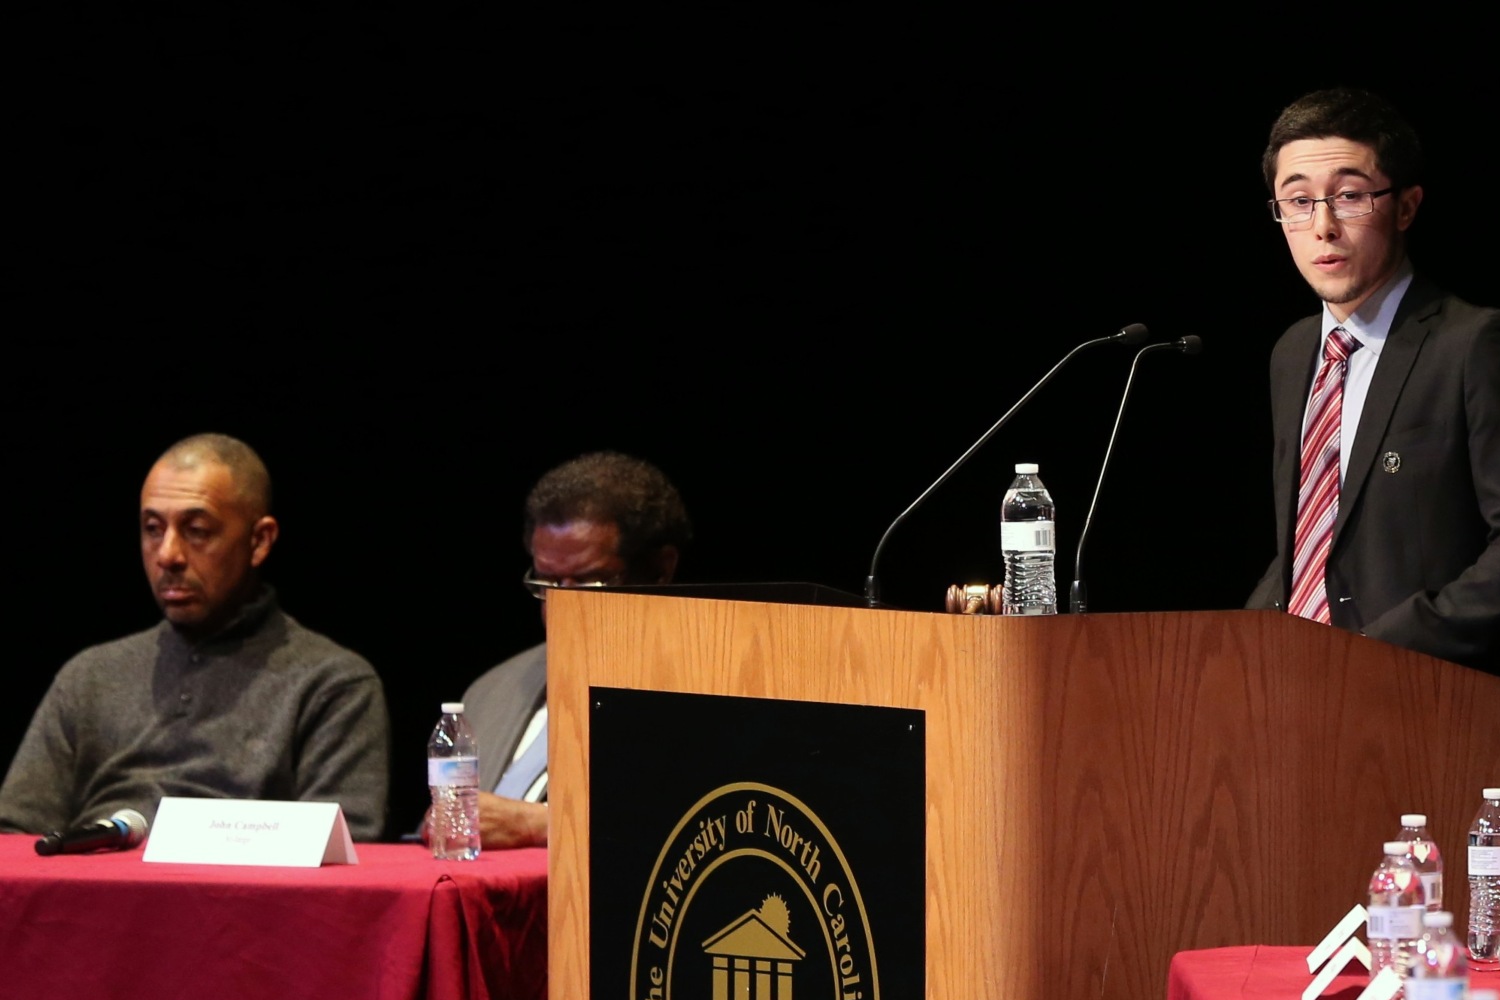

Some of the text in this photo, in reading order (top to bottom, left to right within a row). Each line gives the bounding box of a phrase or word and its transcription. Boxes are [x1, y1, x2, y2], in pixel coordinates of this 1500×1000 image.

[650, 814, 727, 950] University
[735, 799, 757, 835] of
[765, 803, 822, 885] North
